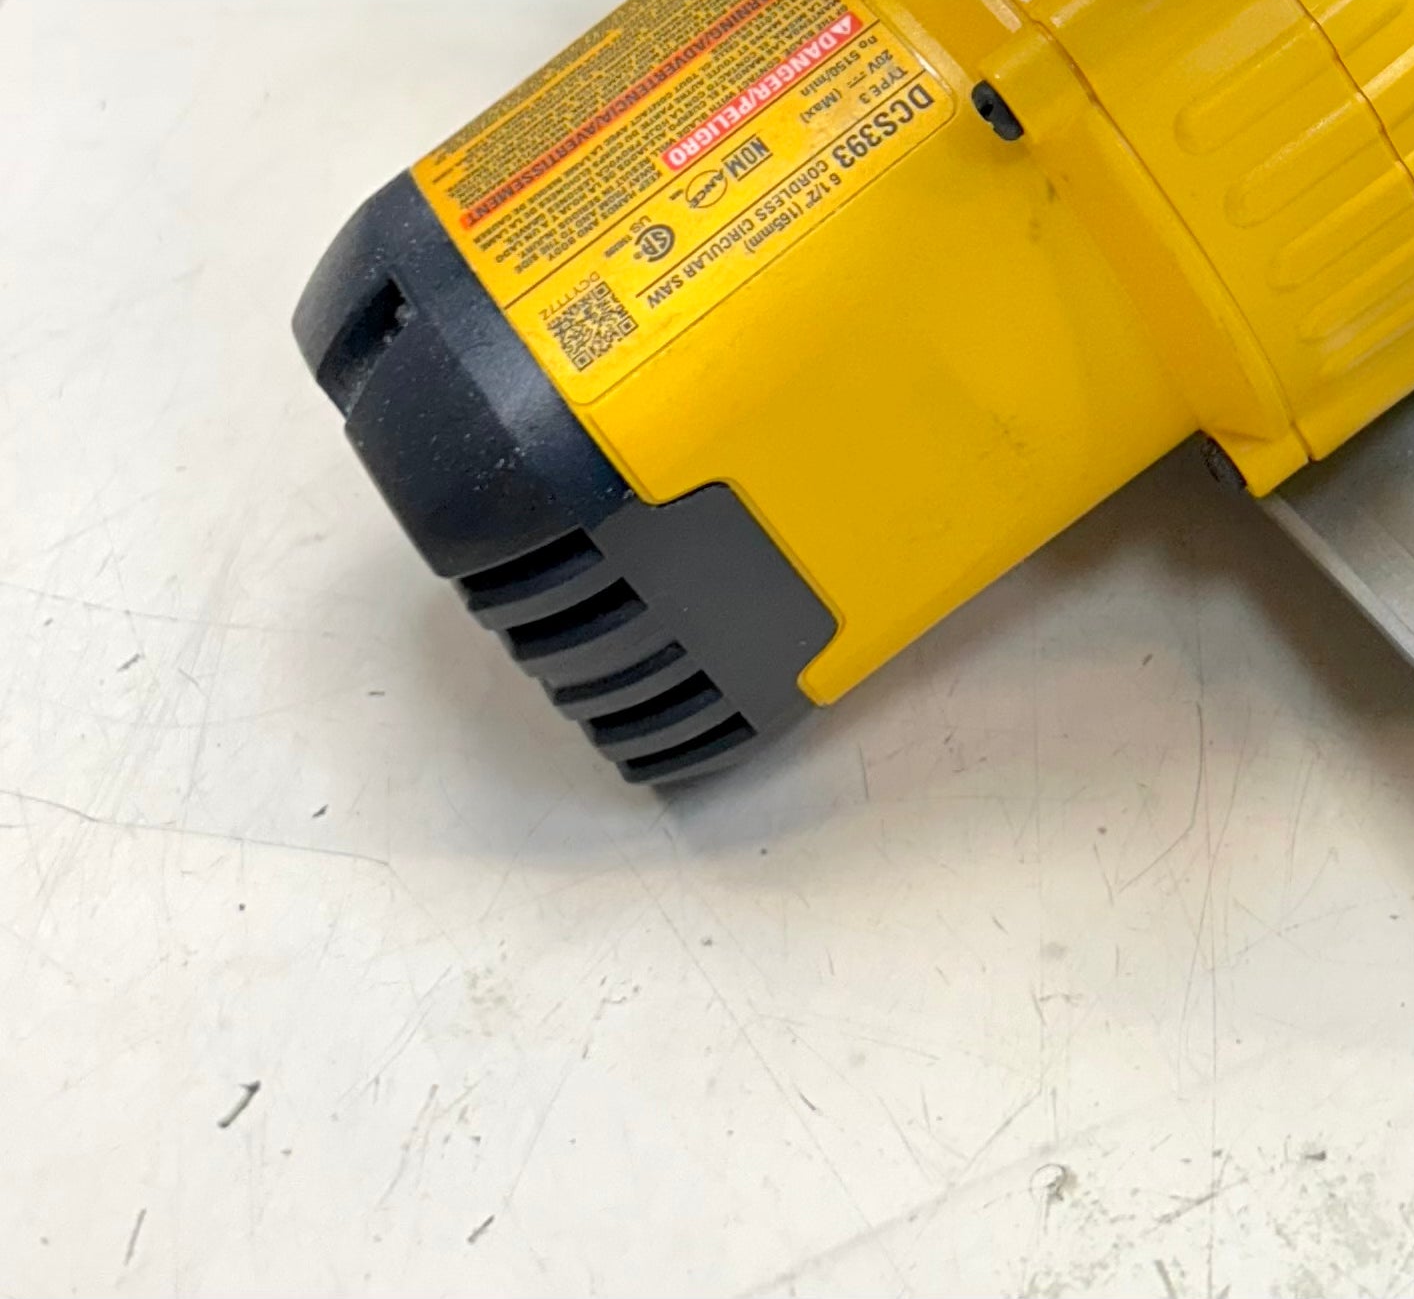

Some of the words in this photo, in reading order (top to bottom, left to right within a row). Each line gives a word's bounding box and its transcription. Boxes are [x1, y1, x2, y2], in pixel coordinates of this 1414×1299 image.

[798, 48, 861, 99] 5150/min
[864, 48, 894, 74] 20V
[867, 63, 908, 97] TYPE
[665, 29, 838, 168] DANGER/PELIGRO
[797, 86, 843, 125] (Max)
[856, 91, 871, 105] 3
[829, 82, 935, 171] DCS393
[649, 136, 677, 159] WILL
[722, 136, 770, 178] NOM
[613, 155, 651, 186] RESULT
[626, 162, 657, 188] AWAY
[635, 169, 663, 192] KEEP
[827, 171, 843, 186] 6
[596, 185, 627, 210] FROM
[599, 189, 637, 220] HANDS
[752, 158, 830, 222] CORDLESS
[556, 194, 601, 230] SERIOUS
[573, 207, 597, 228] AND
[627, 213, 652, 235] US
[557, 225, 575, 240] TO
[575, 218, 599, 238] AND
[740, 200, 805, 255] (165mm)
[538, 236, 559, 255] THE
[545, 235, 576, 262] BODY
[681, 216, 756, 279] CIRCULAR
[643, 273, 685, 309] SAW
